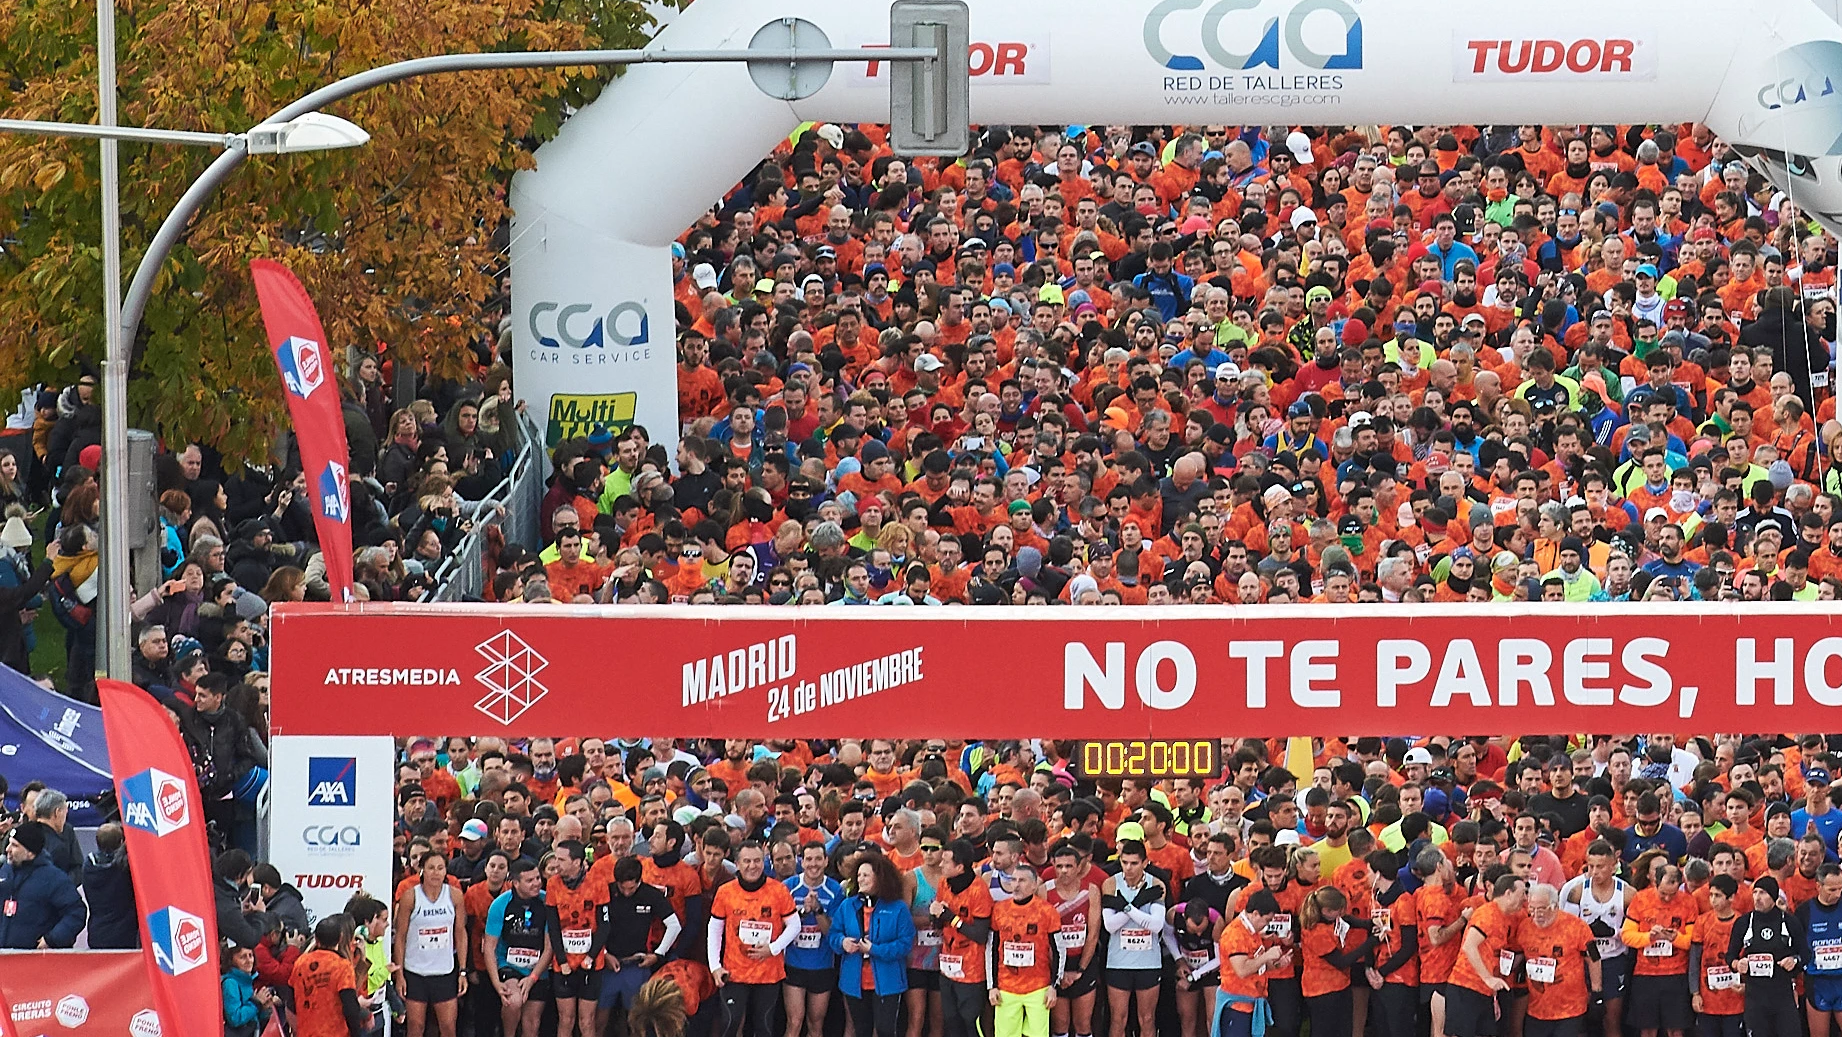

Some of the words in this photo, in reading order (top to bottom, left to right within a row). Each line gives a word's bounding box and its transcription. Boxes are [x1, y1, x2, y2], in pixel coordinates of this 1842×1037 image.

[861, 42, 1028, 77] TOR
[1467, 39, 1635, 75] TUDOR
[1164, 75, 1202, 91] RED
[1210, 75, 1235, 91] DE
[1242, 75, 1343, 91] TALLERES
[530, 349, 559, 364] CAR
[572, 348, 650, 364] SERVICE
[553, 399, 616, 422] Multi
[324, 668, 460, 686] ATRESMEDIA
[682, 633, 797, 707] MADRID
[1063, 640, 1197, 710] NO
[1228, 639, 1341, 707] TE
[1377, 637, 1698, 719] PARES,
[767, 688, 790, 723] 24
[794, 680, 814, 713] de
[819, 646, 924, 707] NOVIEMBRE
[1083, 740, 1213, 775] 00:20:00
[308, 781, 349, 803] AXA
[295, 874, 363, 889] TUDOR
[12, 1000, 52, 1012] CIRCUITO
